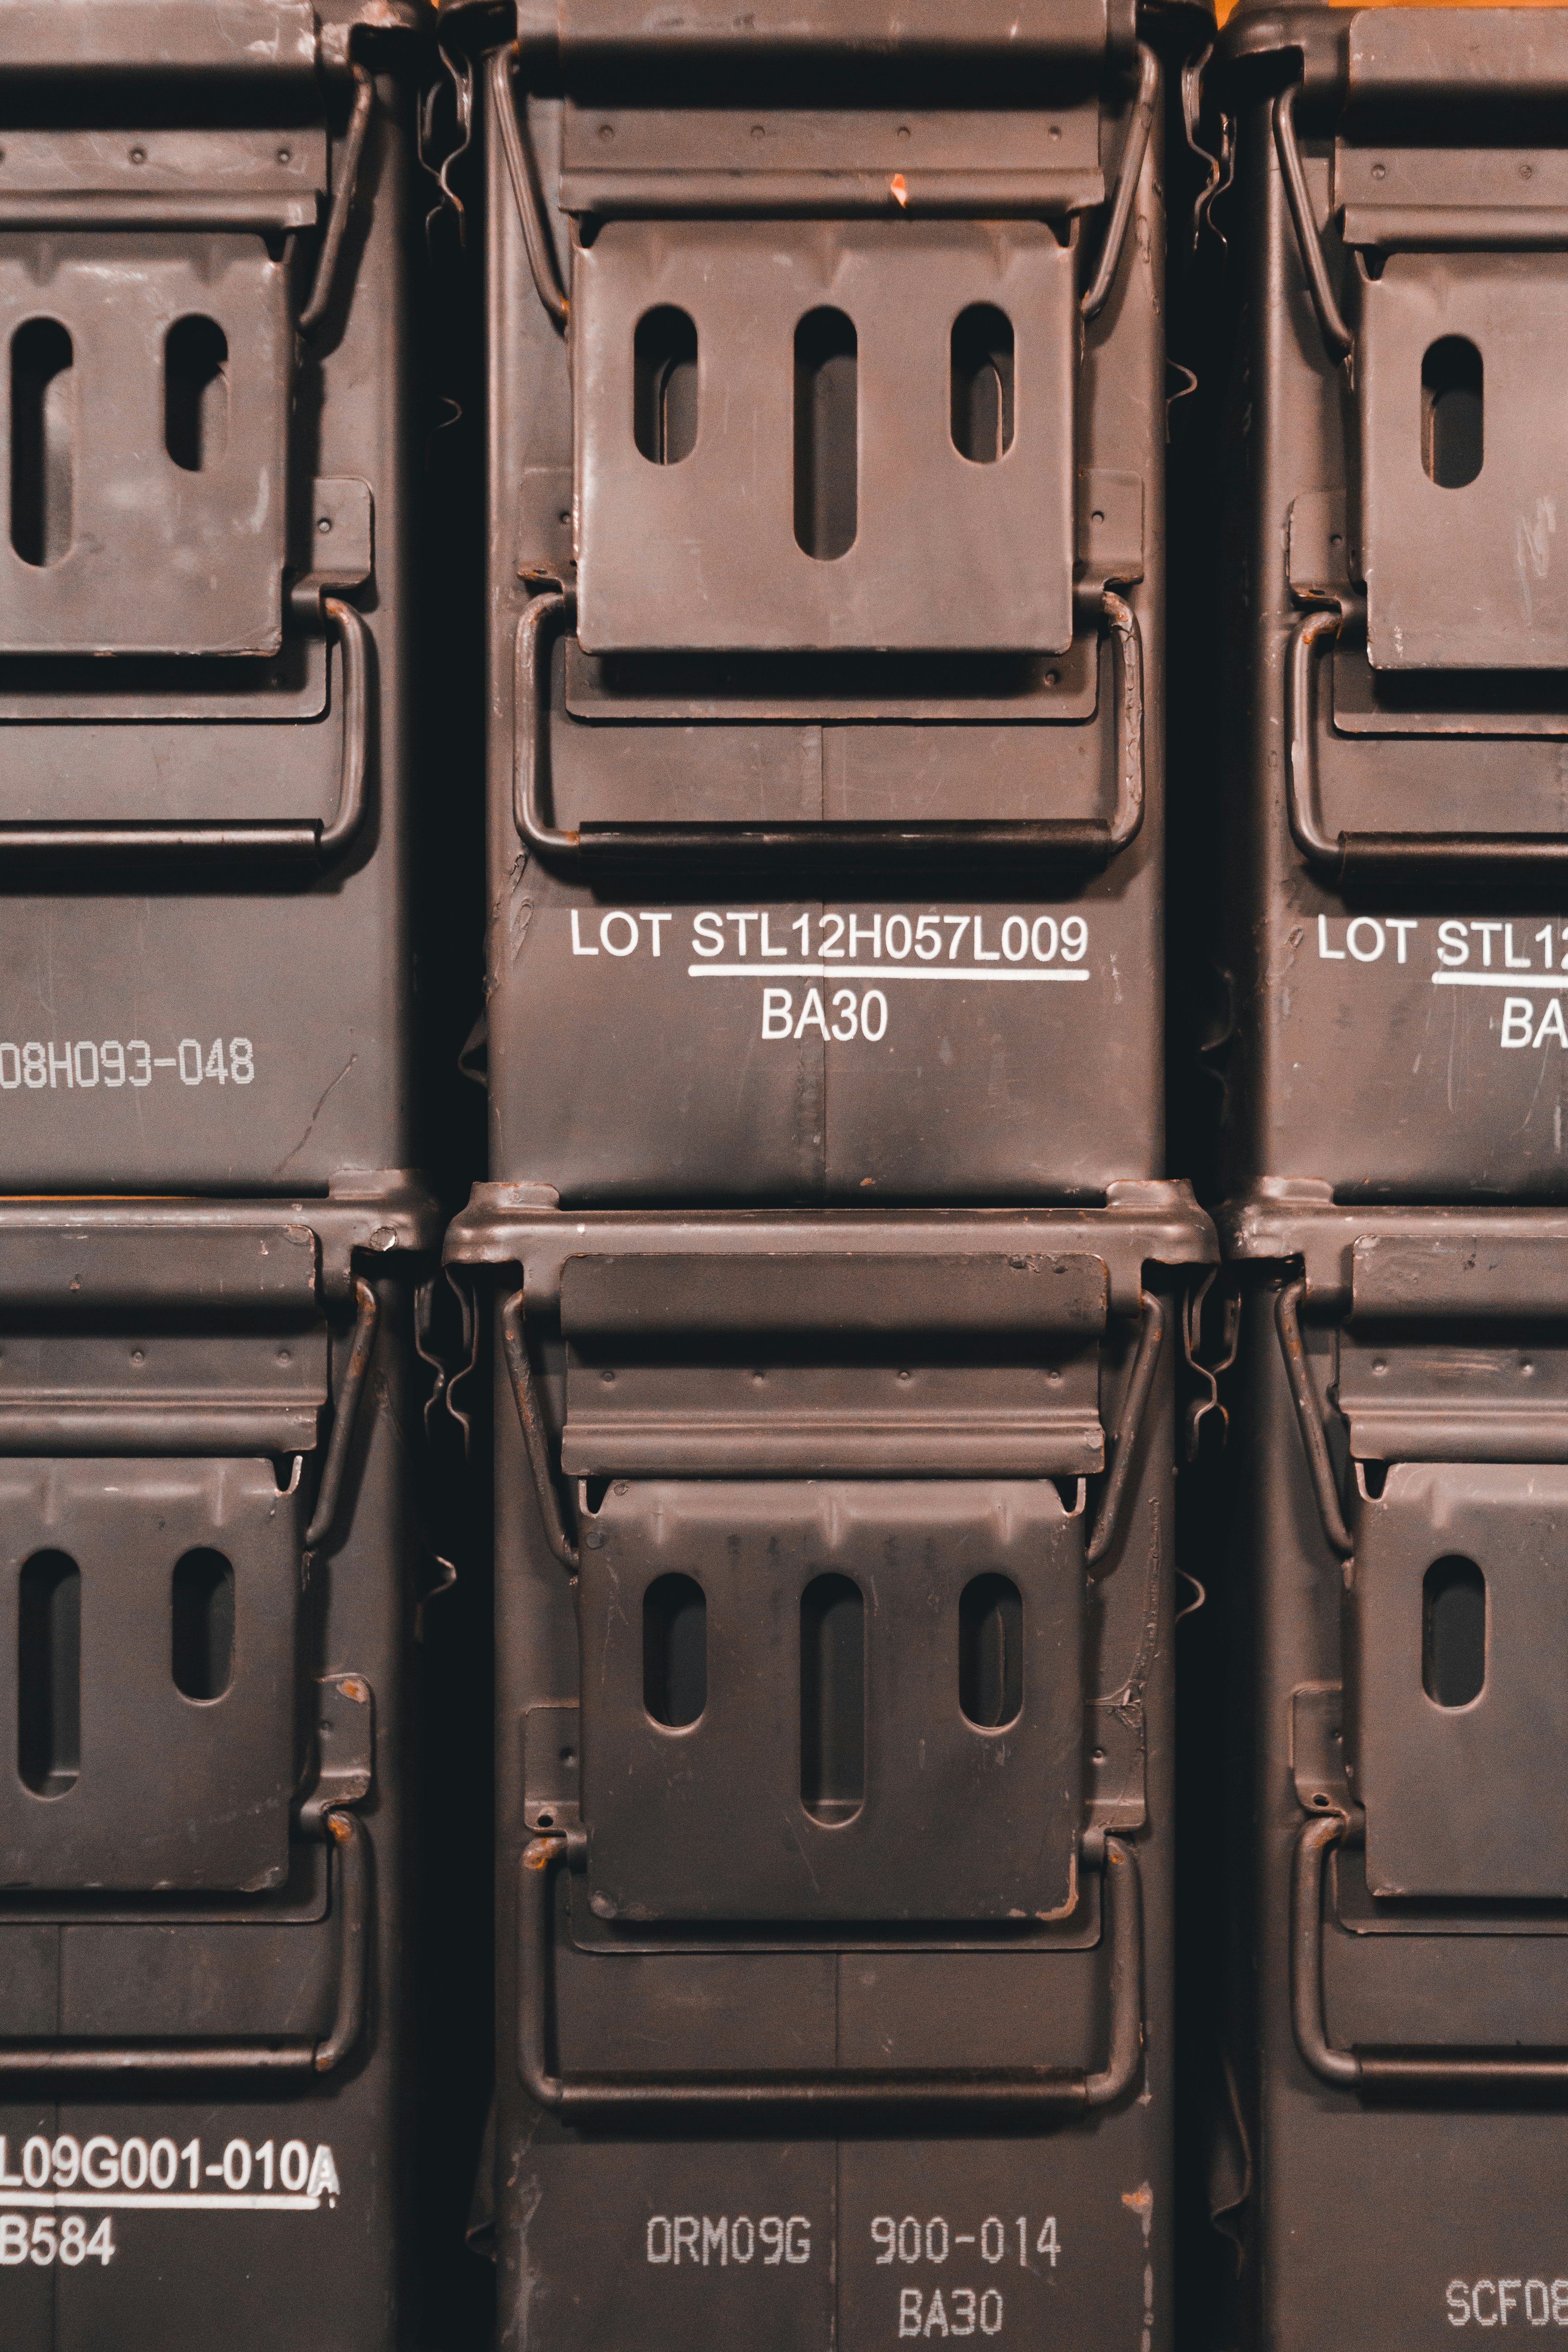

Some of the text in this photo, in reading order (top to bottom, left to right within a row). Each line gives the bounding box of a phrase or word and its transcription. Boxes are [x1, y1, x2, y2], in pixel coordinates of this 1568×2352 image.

[570, 909, 1088, 962] LOT STL12H057L009
[1317, 914, 1568, 970] LOT STL1
[761, 988, 888, 1041] BA30
[0, 1037, 255, 1089] 08H093-048
[0, 2214, 116, 2266] B584
[870, 2215, 1062, 2267] 900-014
[898, 2288, 1003, 2338] BA30
